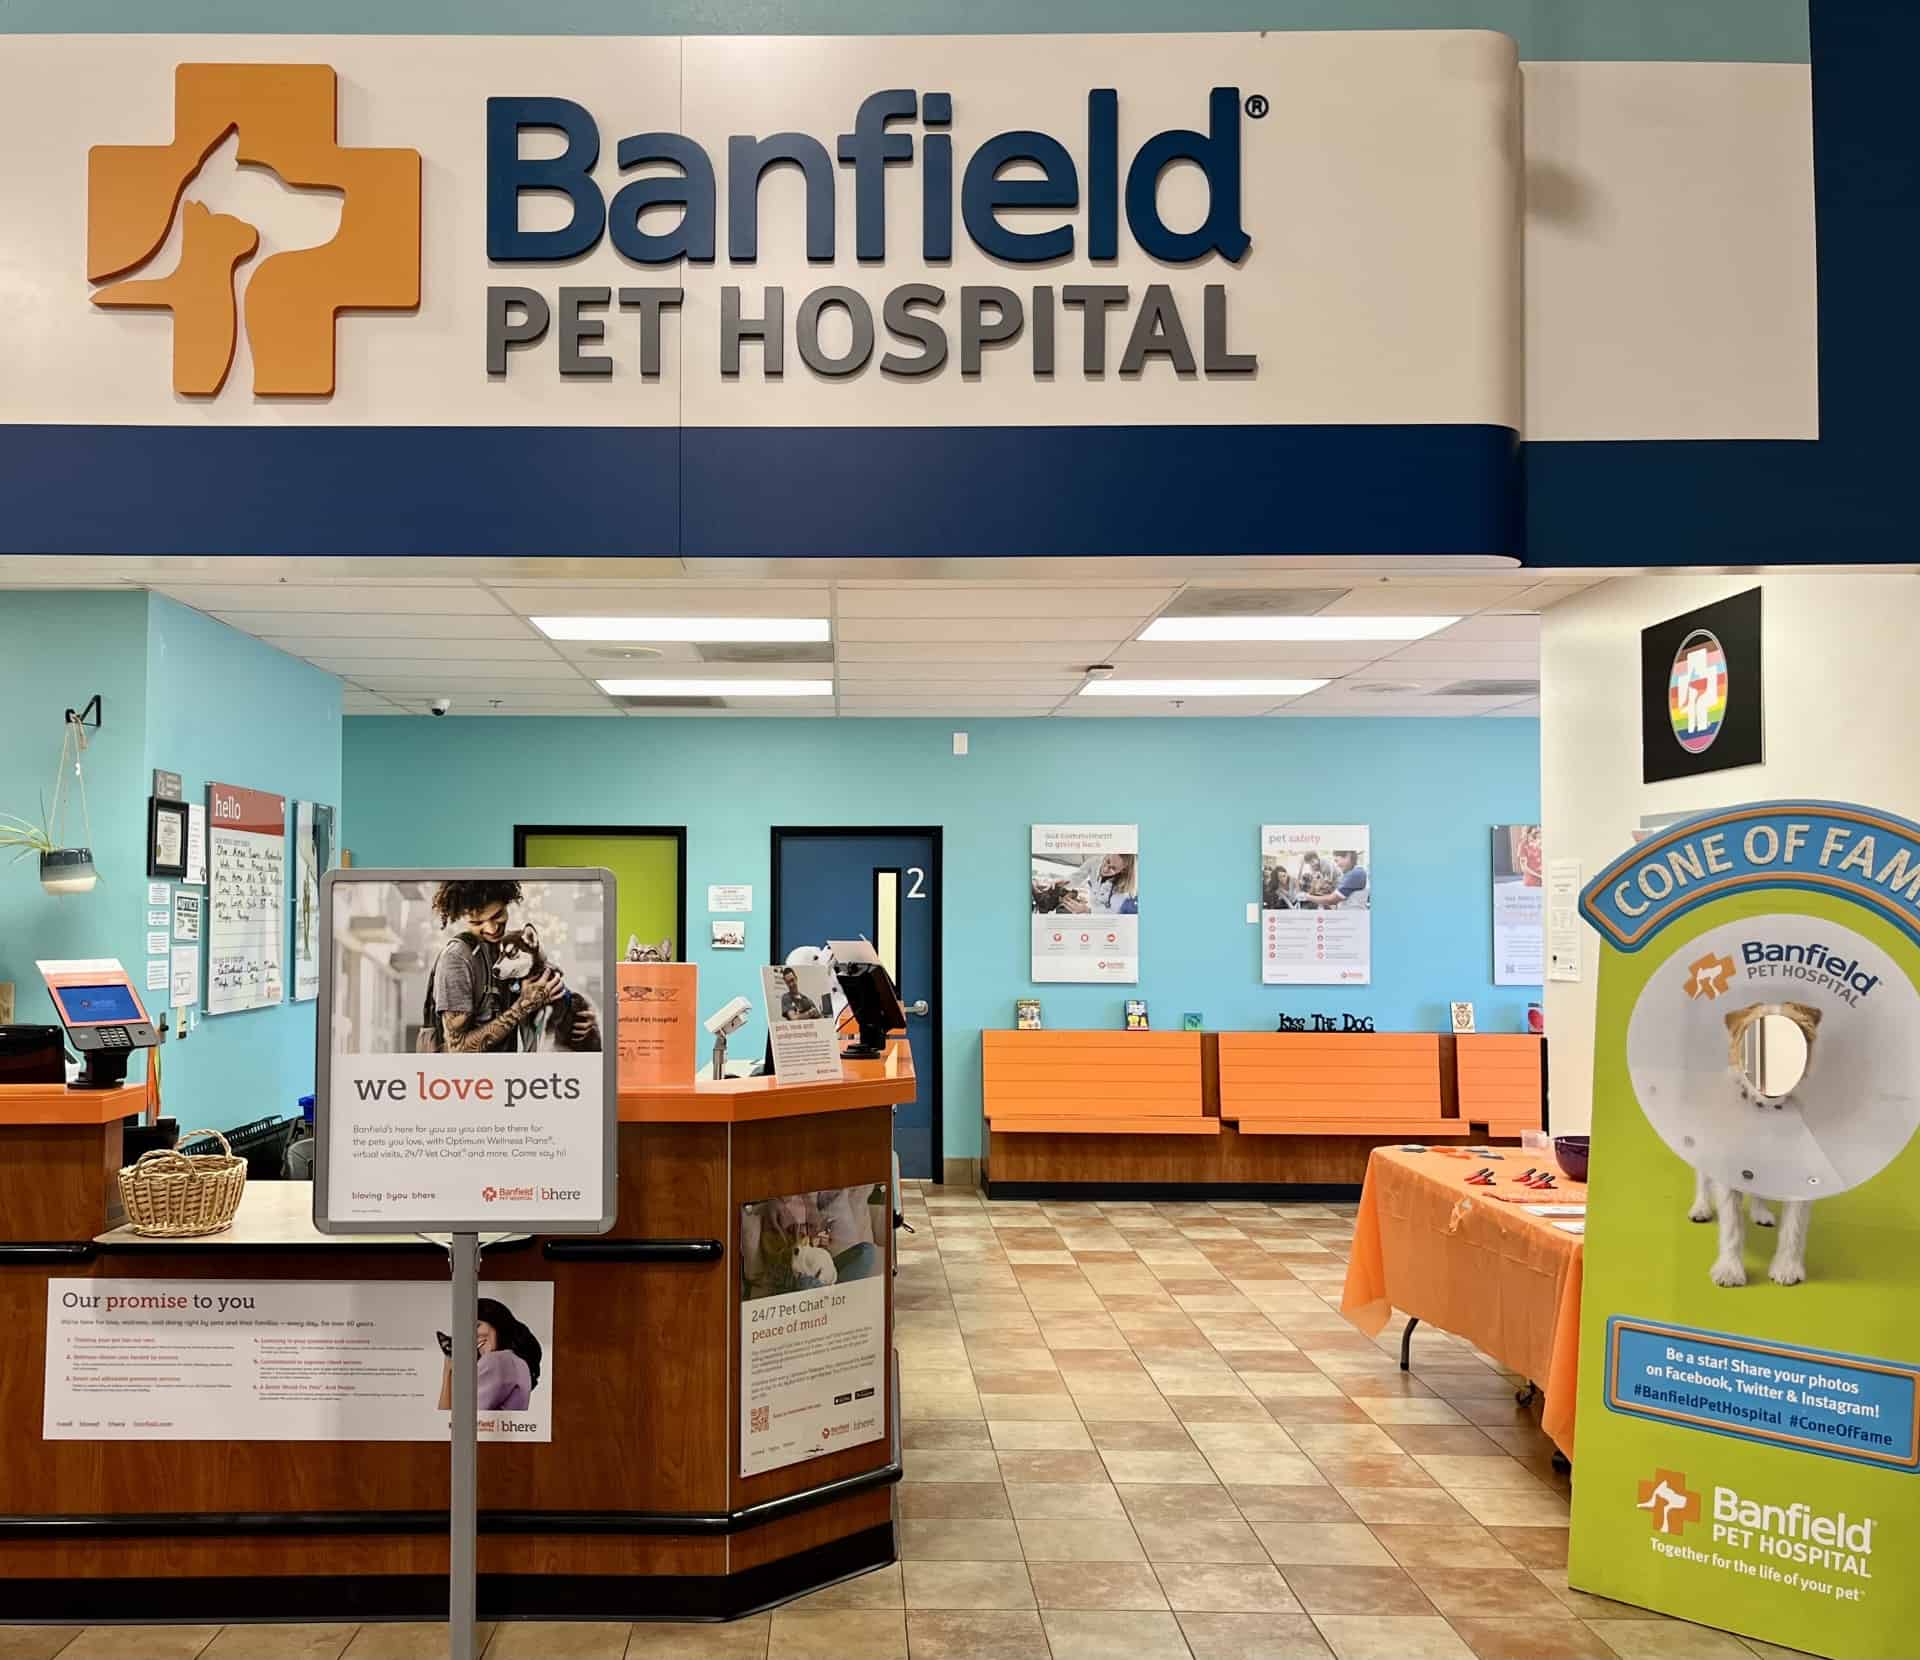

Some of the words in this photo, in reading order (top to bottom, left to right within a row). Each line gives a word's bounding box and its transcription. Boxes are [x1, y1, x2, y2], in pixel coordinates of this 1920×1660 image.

[486, 285, 685, 376] PET
[720, 283, 1258, 377] HOSPITAL
[214, 793, 241, 820] hello
[1269, 833, 1287, 845] pet
[1289, 832, 1320, 845] safety
[906, 867, 926, 899] 2
[1613, 832, 1734, 918] CONE
[1743, 823, 1811, 865] OF
[1818, 826, 1920, 909] FAM
[1747, 964, 1778, 979] PET
[1782, 964, 1858, 1008] HOSPITAL
[353, 1078, 408, 1101] we
[416, 1071, 494, 1101] love
[503, 1072, 581, 1108] pets
[352, 1137, 366, 1146] the
[368, 1137, 386, 1147] pets
[388, 1138, 404, 1148] you
[426, 1136, 444, 1146] with
[415, 1124, 427, 1133] for
[429, 1126, 446, 1136] you
[458, 1126, 475, 1136] you
[495, 1124, 505, 1133] be
[530, 1123, 544, 1133] for
[468, 1149, 485, 1158] and
[541, 1187, 581, 1201] bhere
[62, 1292, 101, 1309] Our
[105, 1292, 188, 1312] promise
[192, 1293, 213, 1309] to
[217, 1296, 256, 1313] you
[751, 1306, 777, 1323] 24/7
[779, 1304, 797, 1318] Pet
[751, 1324, 784, 1344] peace
[786, 1320, 799, 1334] of
[799, 1313, 828, 1330] mind
[1666, 1347, 1685, 1363] Be
[1686, 1353, 1695, 1364] a
[1697, 1355, 1728, 1371] star!
[1731, 1359, 1771, 1378] Share
[1774, 1369, 1806, 1386] your
[1808, 1374, 1859, 1395] photos
[1646, 1365, 1663, 1377] on
[1665, 1366, 1732, 1393] Facebook,
[1735, 1379, 1784, 1401] Twitter
[1786, 1390, 1798, 1403] &
[1801, 1391, 1880, 1419] Instagram!
[501, 1420, 537, 1432] bhere
[1633, 1383, 1782, 1425] #BanfieldPetHospital
[1789, 1414, 1893, 1446] #ConeOfFame
[1712, 1485, 1873, 1555] Banfield
[1650, 1536, 1711, 1565] Together
[1711, 1551, 1732, 1570] for
[1733, 1559, 1757, 1576] the
[1759, 1564, 1782, 1584] life
[1783, 1572, 1800, 1586] of
[1799, 1578, 1833, 1596] your
[1712, 1523, 1754, 1549] PET
[1759, 1534, 1873, 1579] HOSPITAL
